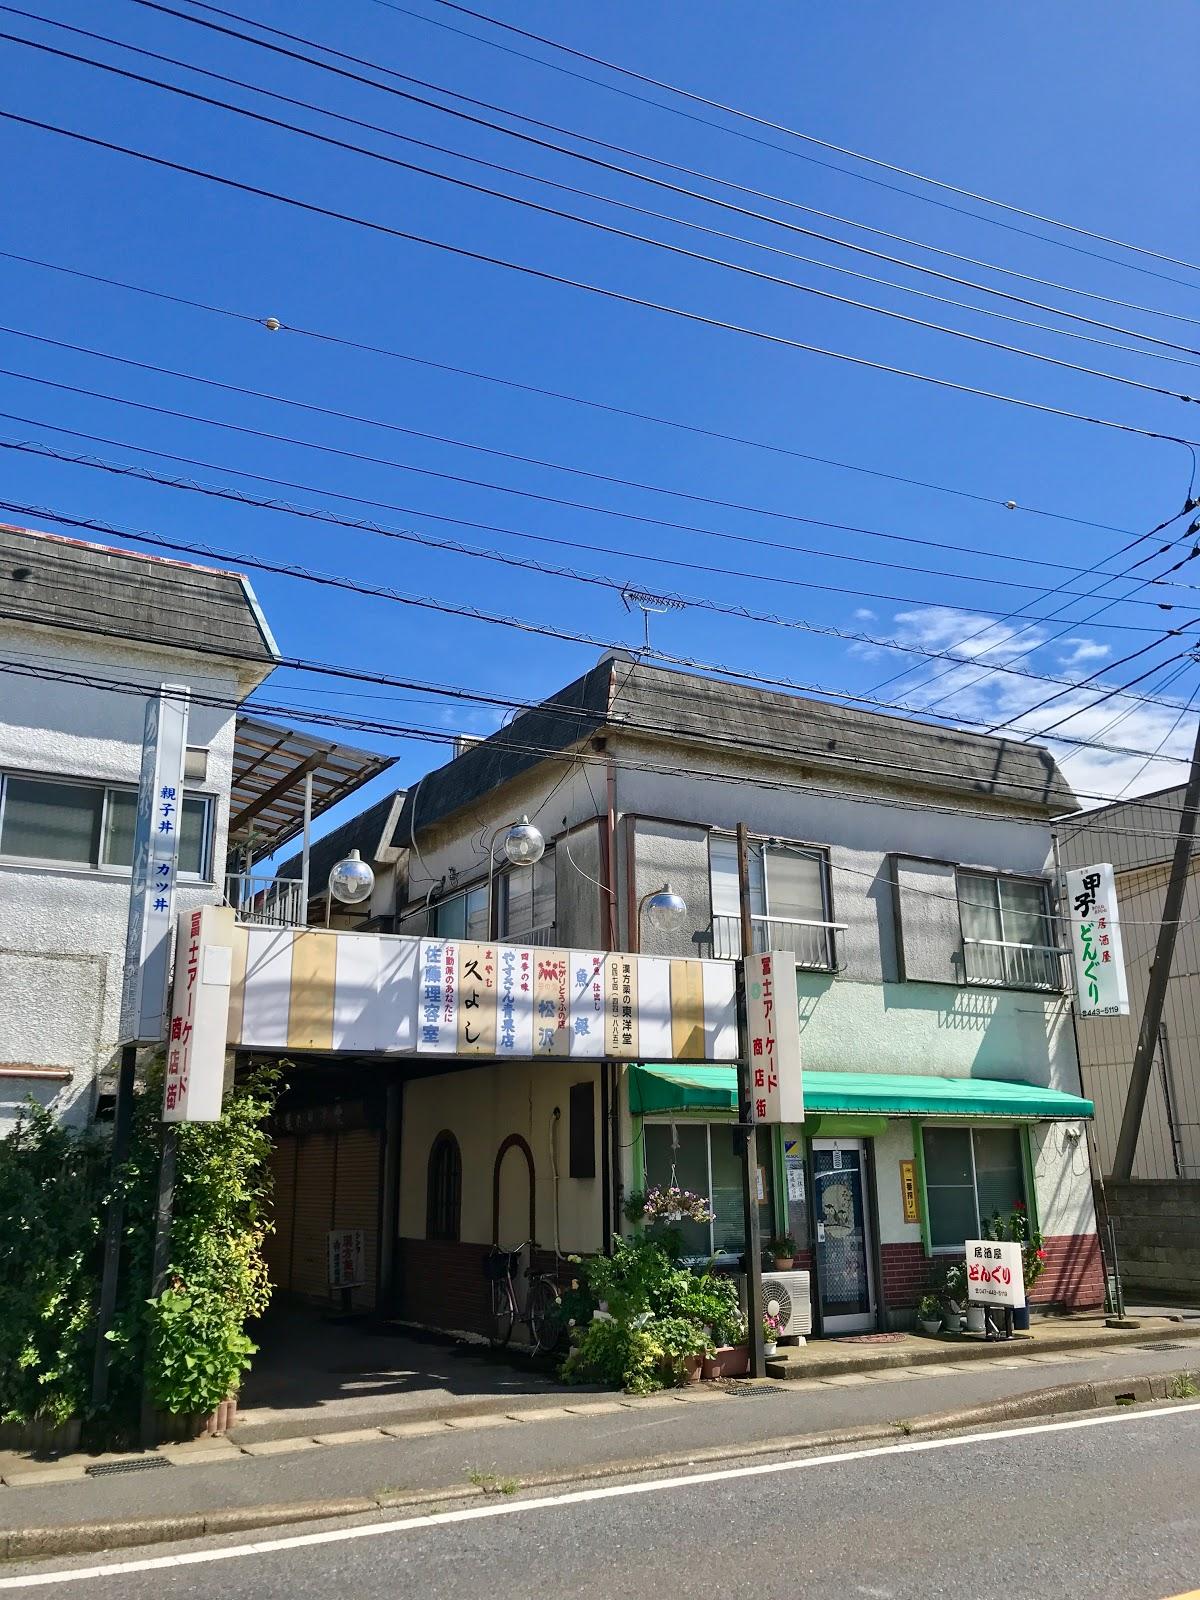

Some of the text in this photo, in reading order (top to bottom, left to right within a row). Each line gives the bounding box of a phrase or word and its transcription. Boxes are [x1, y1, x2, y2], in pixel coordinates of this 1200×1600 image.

[1074, 872, 1101, 918] 甲子
[1080, 922, 1100, 1005] どんぐり
[1098, 917, 1112, 963] 居酒屋
[422, 945, 442, 1043] 佐藤理容室
[520, 953, 530, 992] 四季の味
[558, 961, 567, 1030] にがりとうふの店
[592, 982, 601, 1011] 仕出し
[463, 959, 483, 1044] 久よし
[538, 999, 556, 1046] 松沢
[574, 968, 591, 1036] 魚銀
[622, 964, 632, 1045] 漢方薬の東洋堂
[1087, 1005, 1119, 1016] 443-5119
[166, 1015, 182, 1110] 商店街
[753, 1038, 767, 1118] 商店街
[969, 1263, 1011, 1285] どんぐり
[974, 1246, 1002, 1260] 居酒屋
